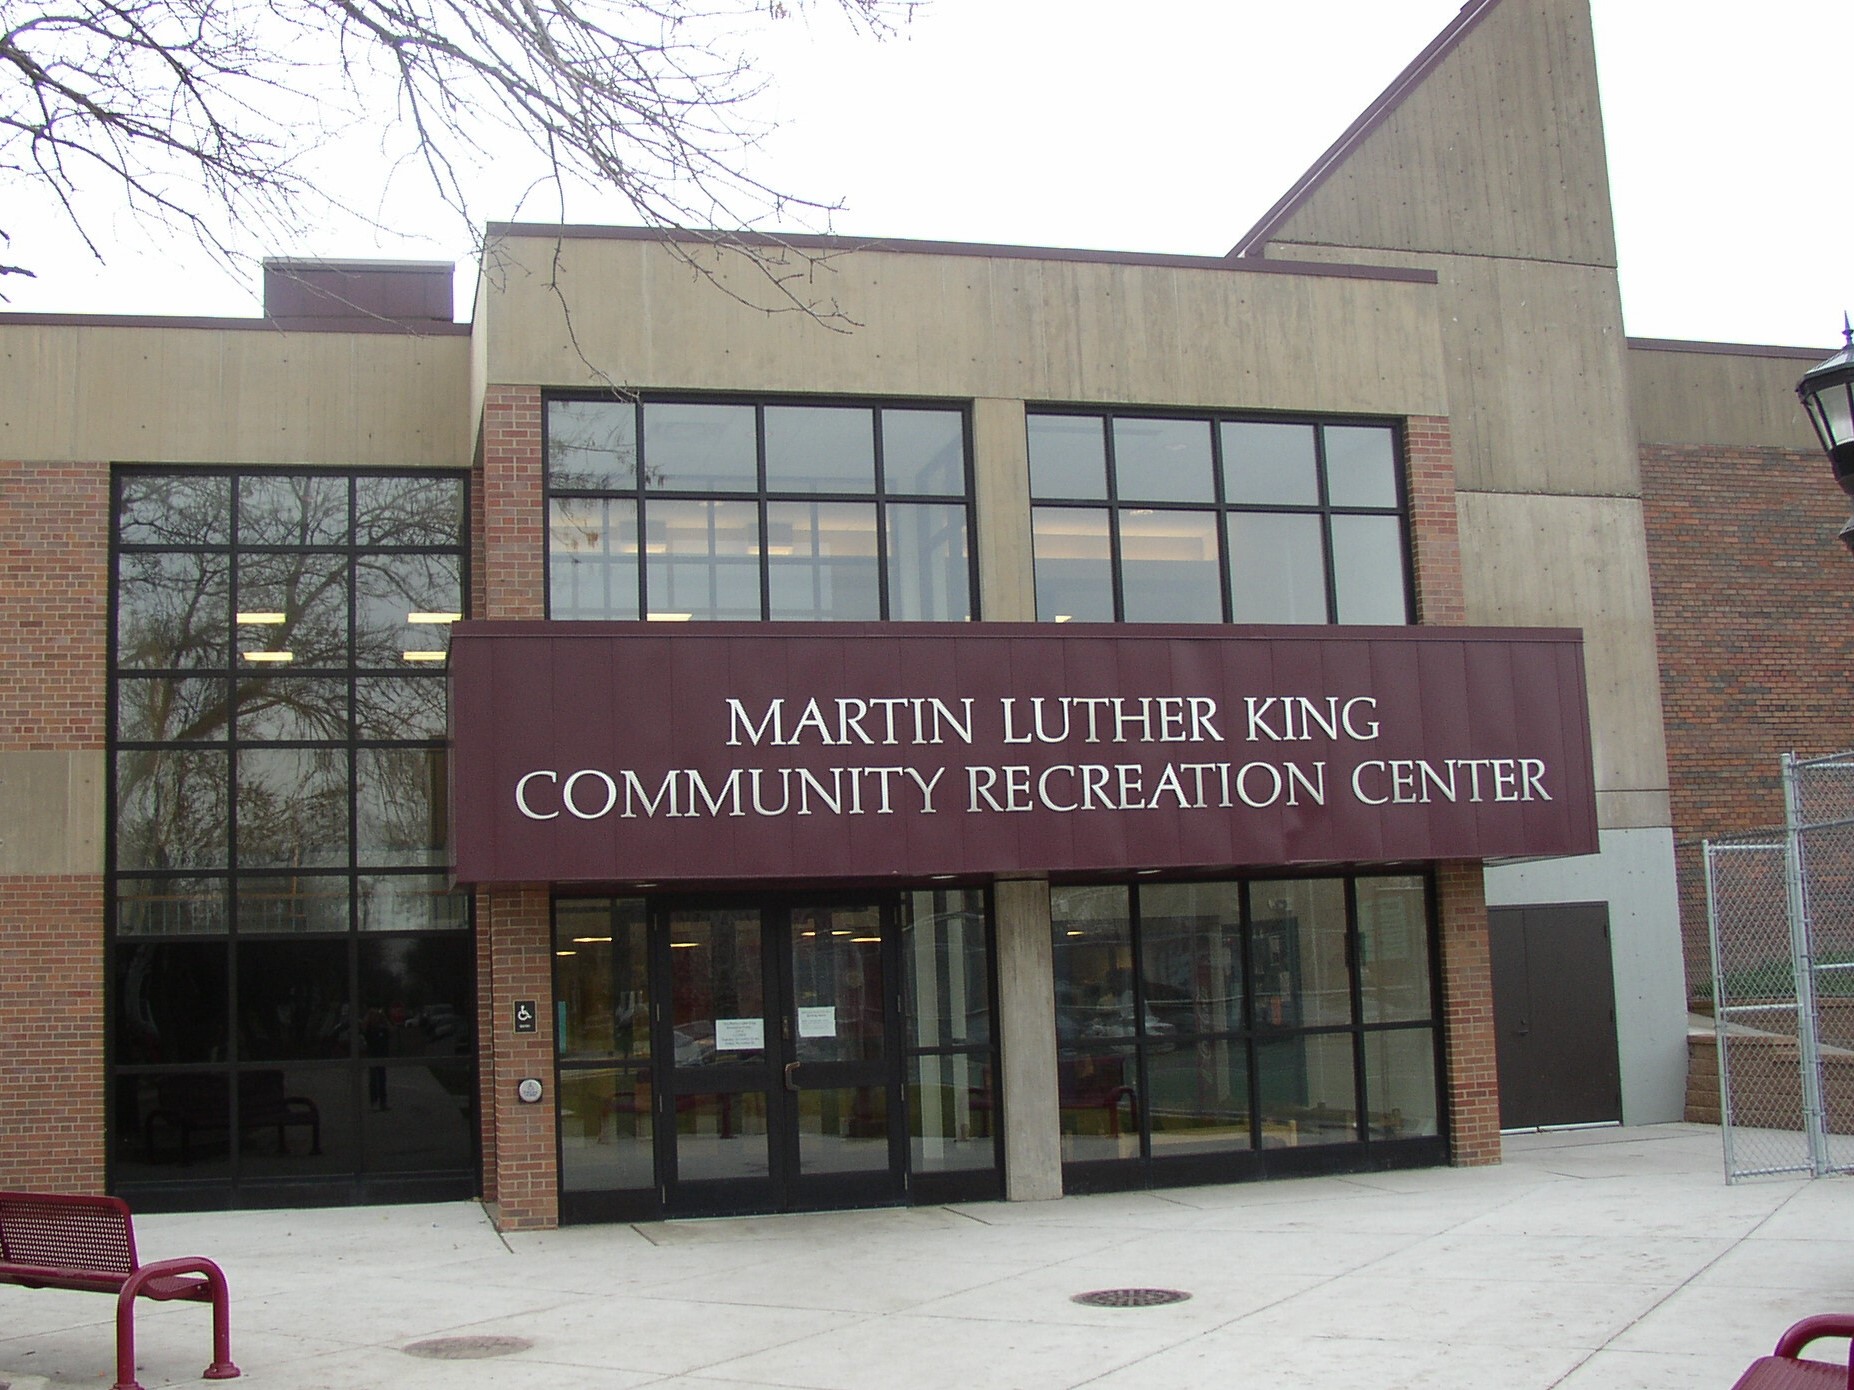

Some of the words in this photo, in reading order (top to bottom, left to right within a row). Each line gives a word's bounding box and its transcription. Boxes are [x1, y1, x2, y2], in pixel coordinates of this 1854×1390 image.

[726, 698, 974, 745] MARTIN
[1001, 698, 1224, 743] LUTHER
[1244, 697, 1379, 740] KING
[516, 767, 944, 819] COMMUNITY
[965, 762, 1325, 811] RECREATION
[1353, 759, 1552, 804] CENTER
